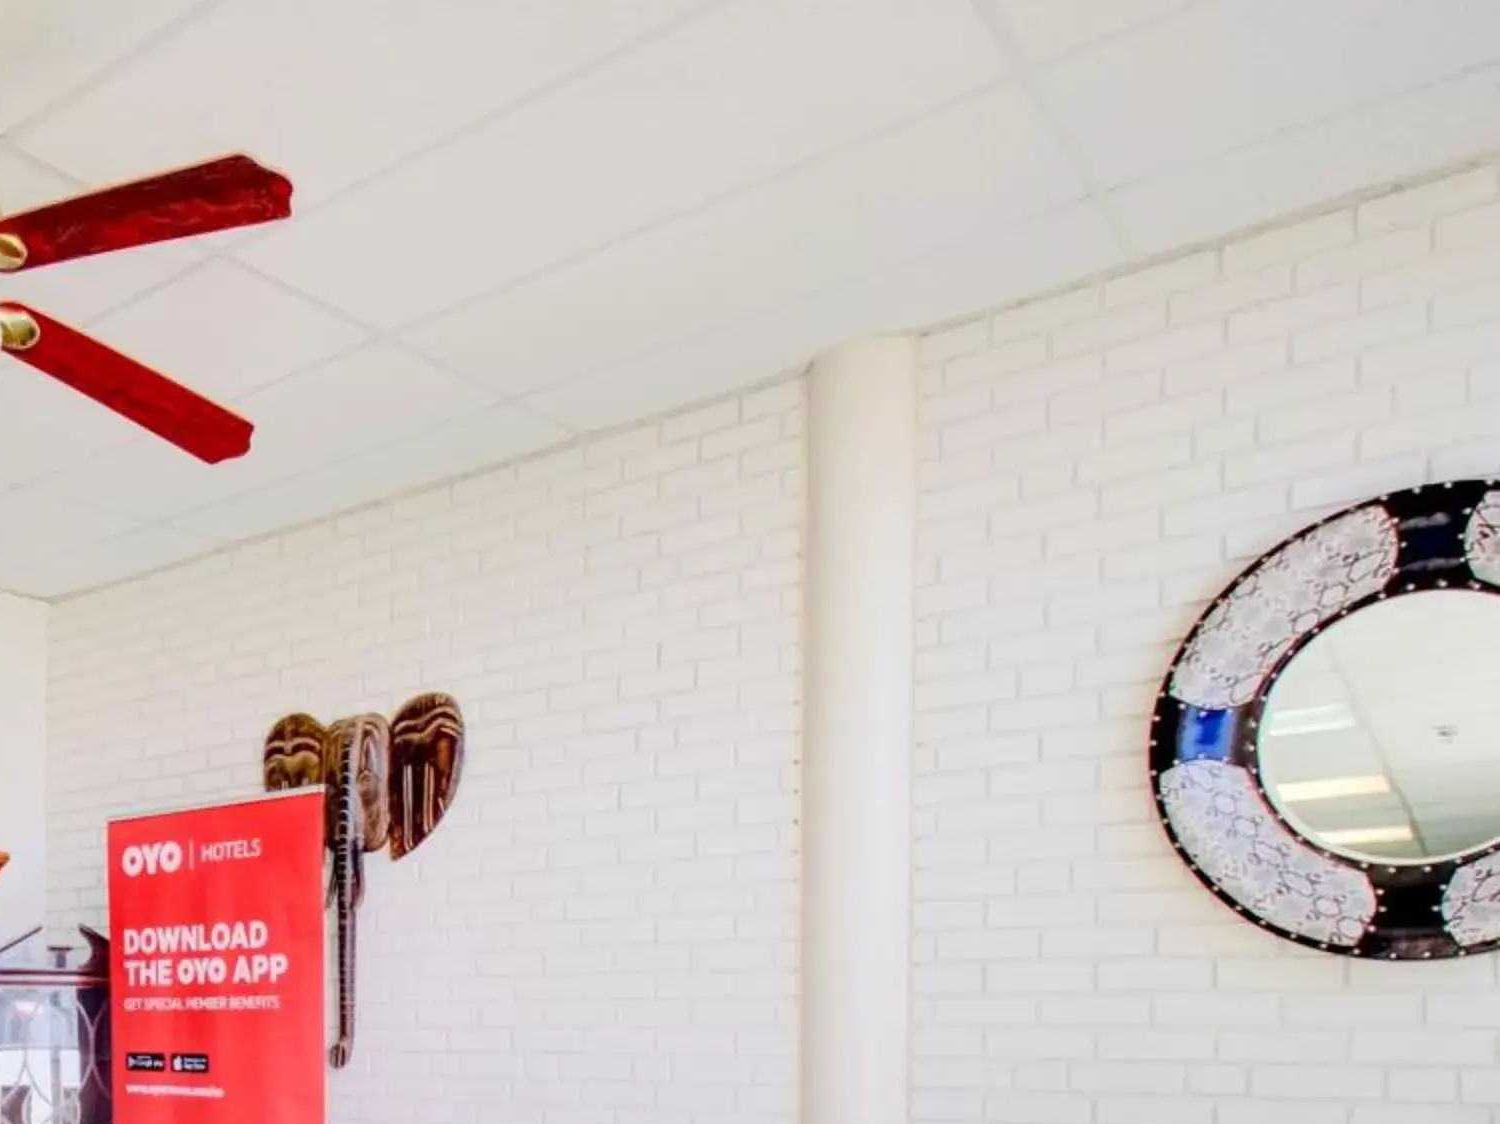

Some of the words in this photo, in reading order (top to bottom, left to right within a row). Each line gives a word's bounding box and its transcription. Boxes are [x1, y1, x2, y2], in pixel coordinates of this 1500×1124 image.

[121, 840, 183, 878] OYO
[201, 838, 261, 862] HOTELS
[123, 920, 268, 955] DOWNLOAD
[123, 959, 173, 987] THE
[177, 957, 227, 985] OYO
[232, 953, 289, 983] APP
